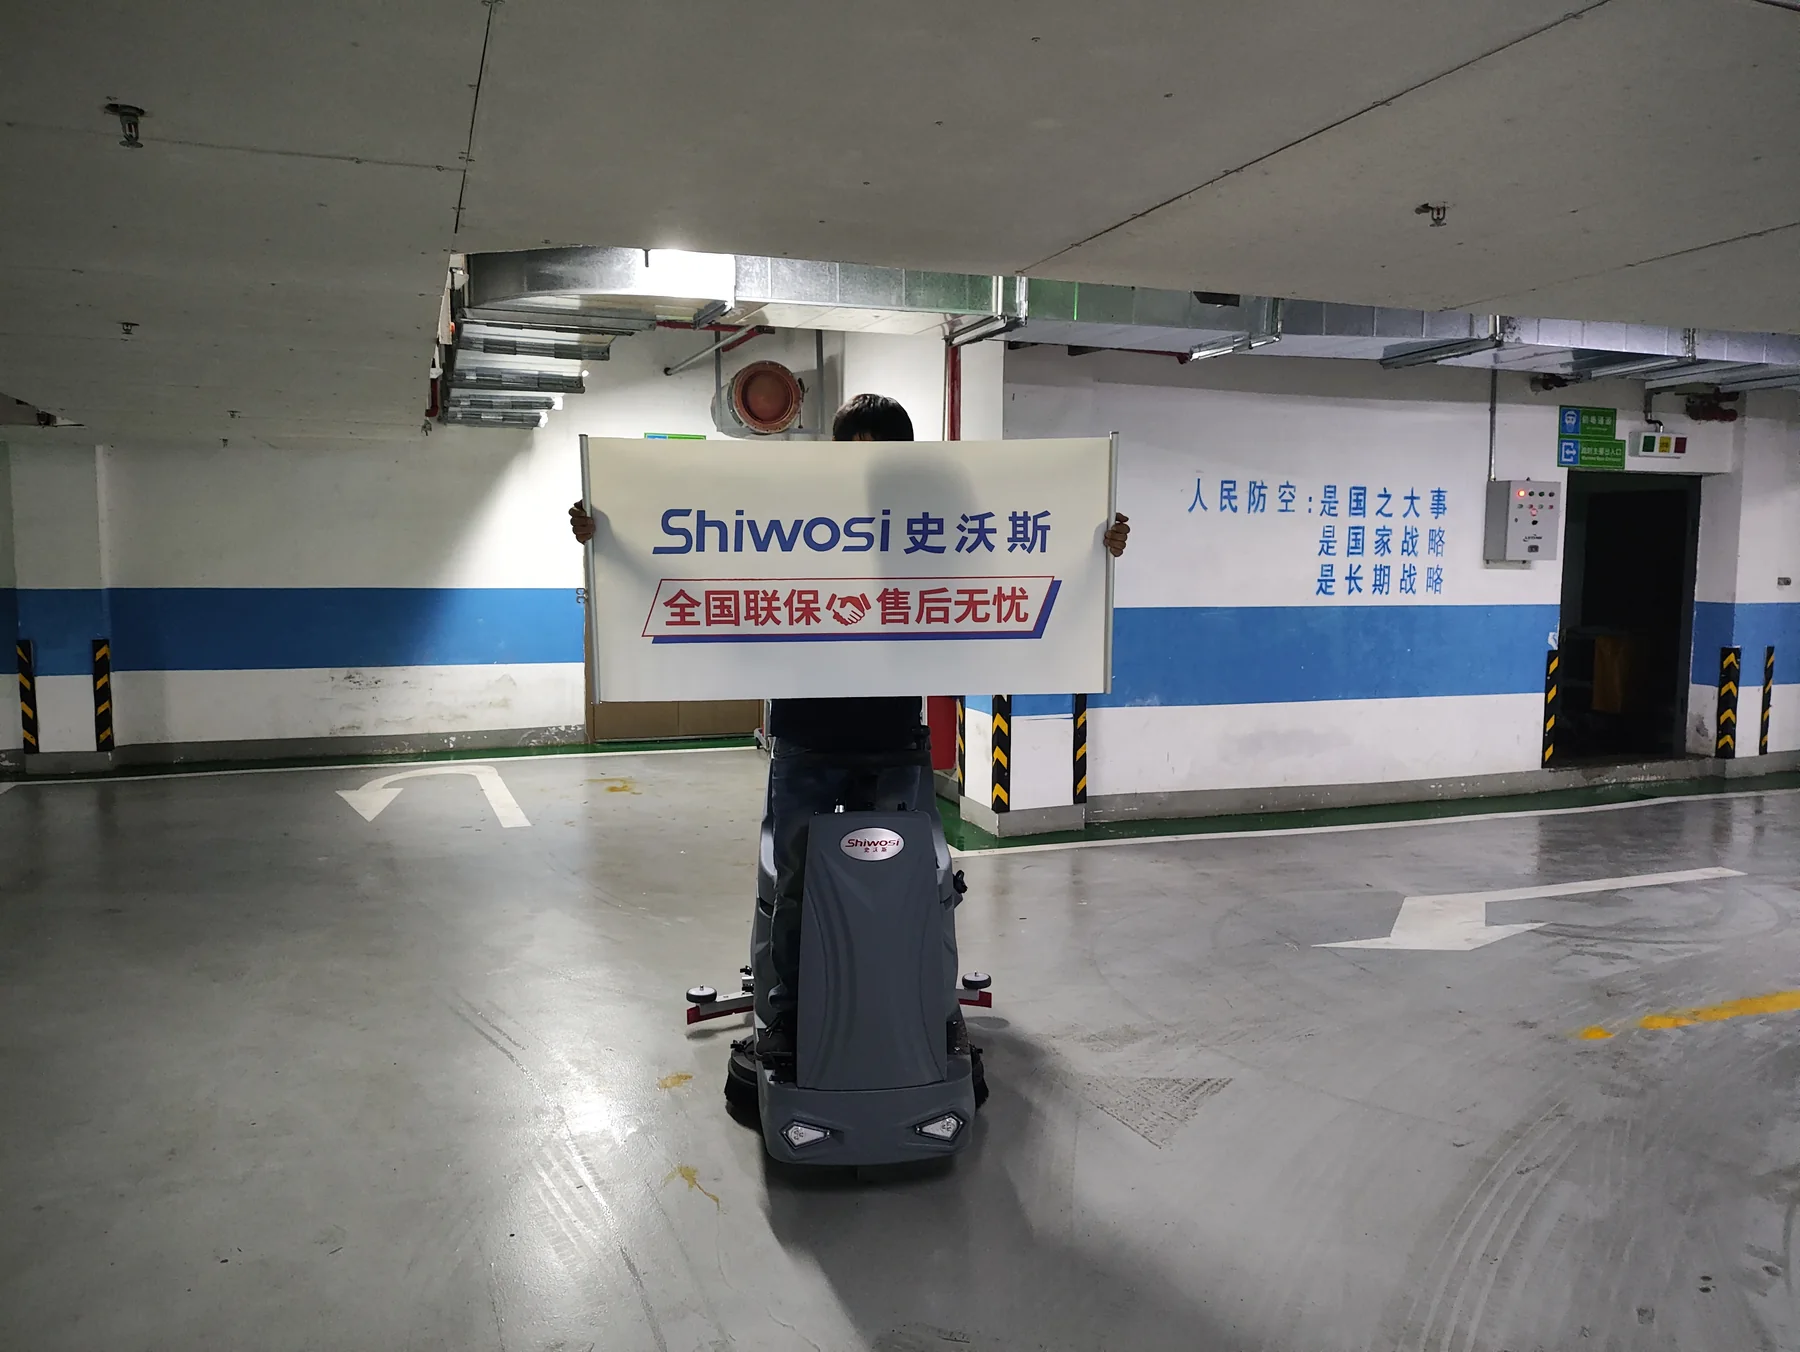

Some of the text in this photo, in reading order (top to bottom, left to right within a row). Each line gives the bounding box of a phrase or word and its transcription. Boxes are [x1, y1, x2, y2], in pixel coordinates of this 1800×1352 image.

[652, 508, 1052, 554] Shiwosi 史沃斯
[1317, 524, 1447, 558] 是国家战略
[1315, 562, 1445, 597] 是长期战略
[663, 586, 1030, 627] 全国联保 售后无忧
[845, 838, 900, 847] Shiwosi
